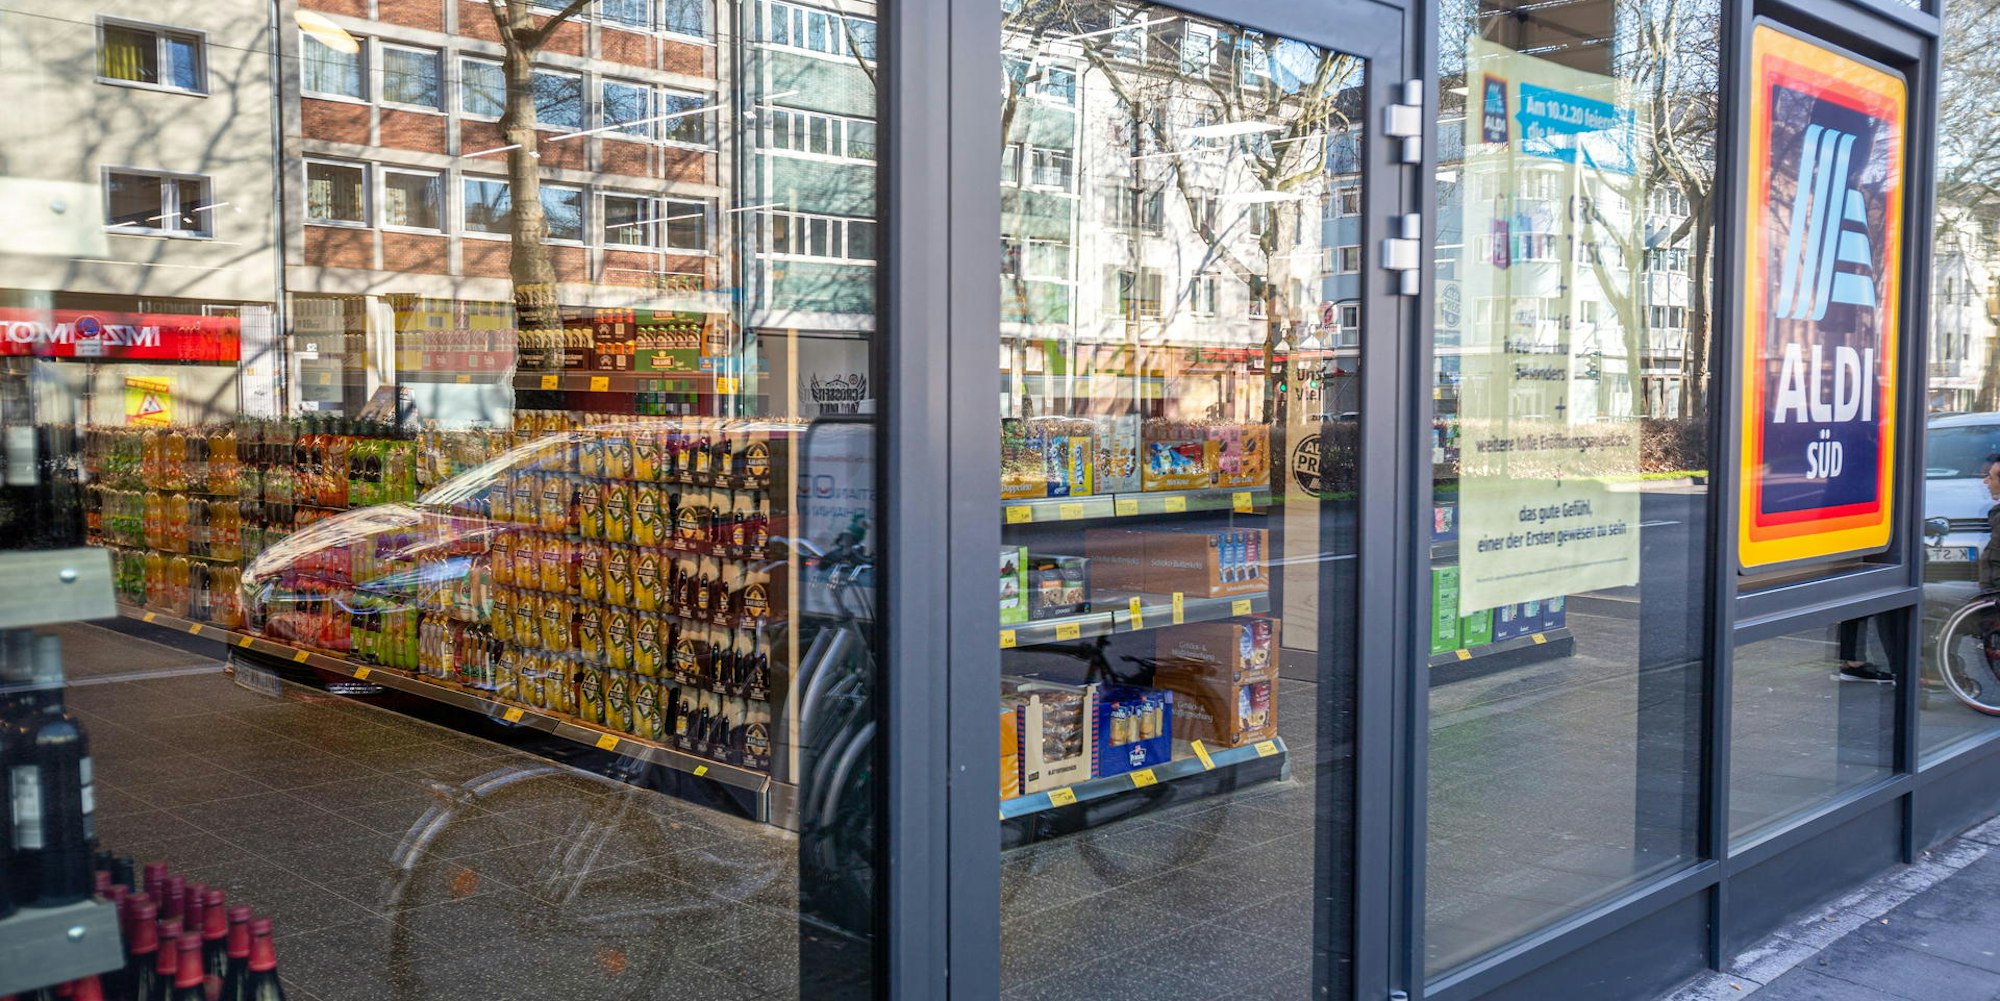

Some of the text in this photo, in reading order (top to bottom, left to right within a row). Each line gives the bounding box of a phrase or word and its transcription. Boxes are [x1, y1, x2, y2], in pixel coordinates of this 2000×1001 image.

[1485, 116, 1506, 132] ALDI
[1527, 96, 1546, 117] Am
[1547, 100, 1583, 125] 10.2.20
[1772, 342, 1874, 424] ALDI
[1805, 428, 1844, 480] SÜD
[1519, 499, 1592, 524] das gute Gefühl,
[1477, 518, 1627, 552] einer der Ersten gewesen zu sein
